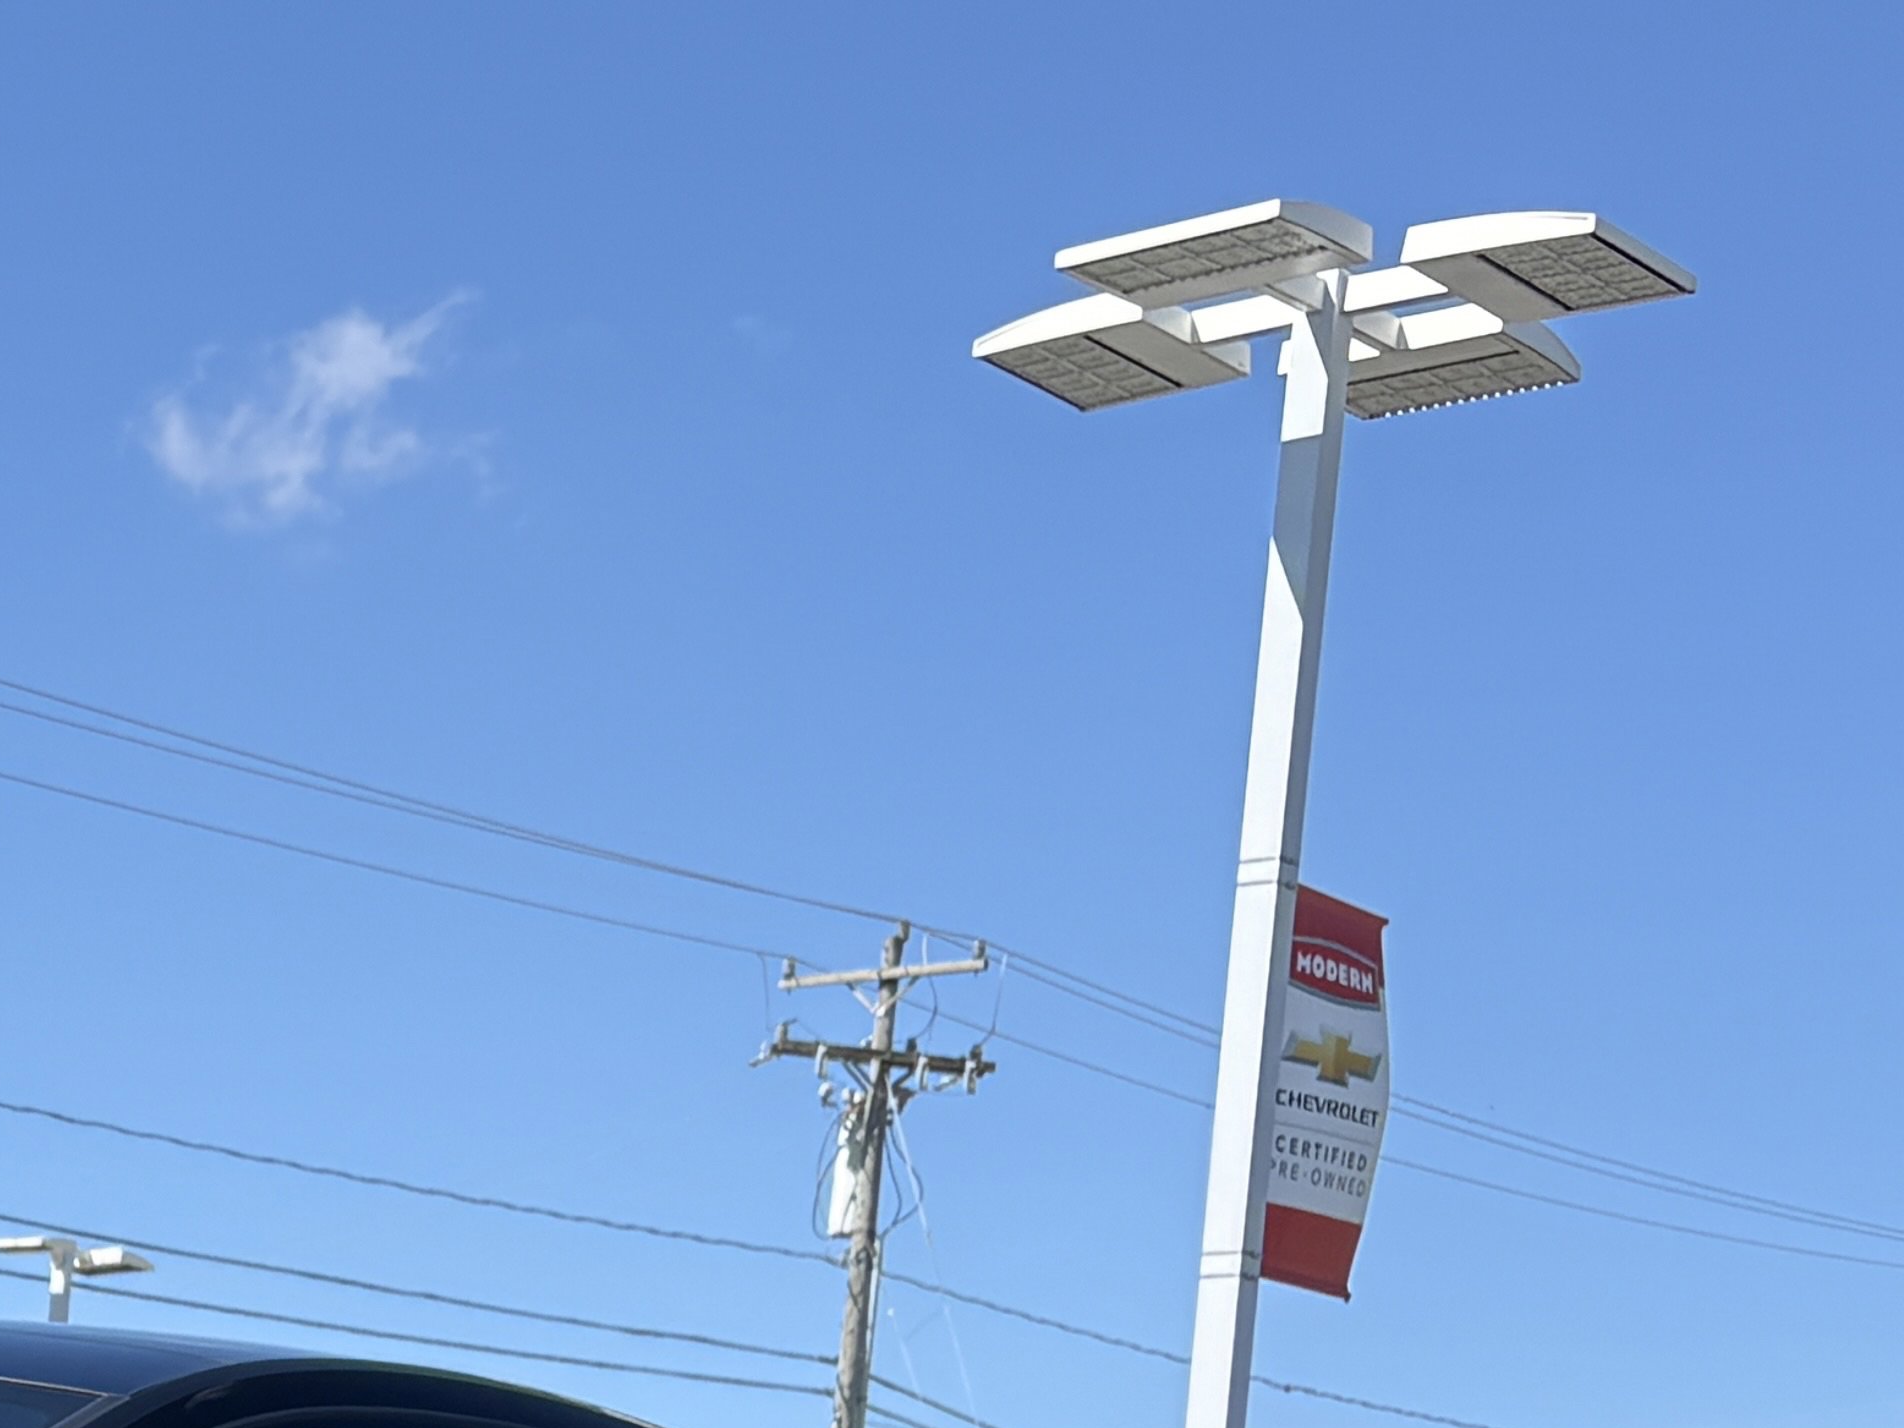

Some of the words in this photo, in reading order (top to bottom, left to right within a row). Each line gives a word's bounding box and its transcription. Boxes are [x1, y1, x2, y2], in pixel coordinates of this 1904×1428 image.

[1296, 950, 1374, 994] MODERN
[1275, 1088, 1379, 1128] CHEVROLET
[1275, 1134, 1367, 1172] CERTIFIED
